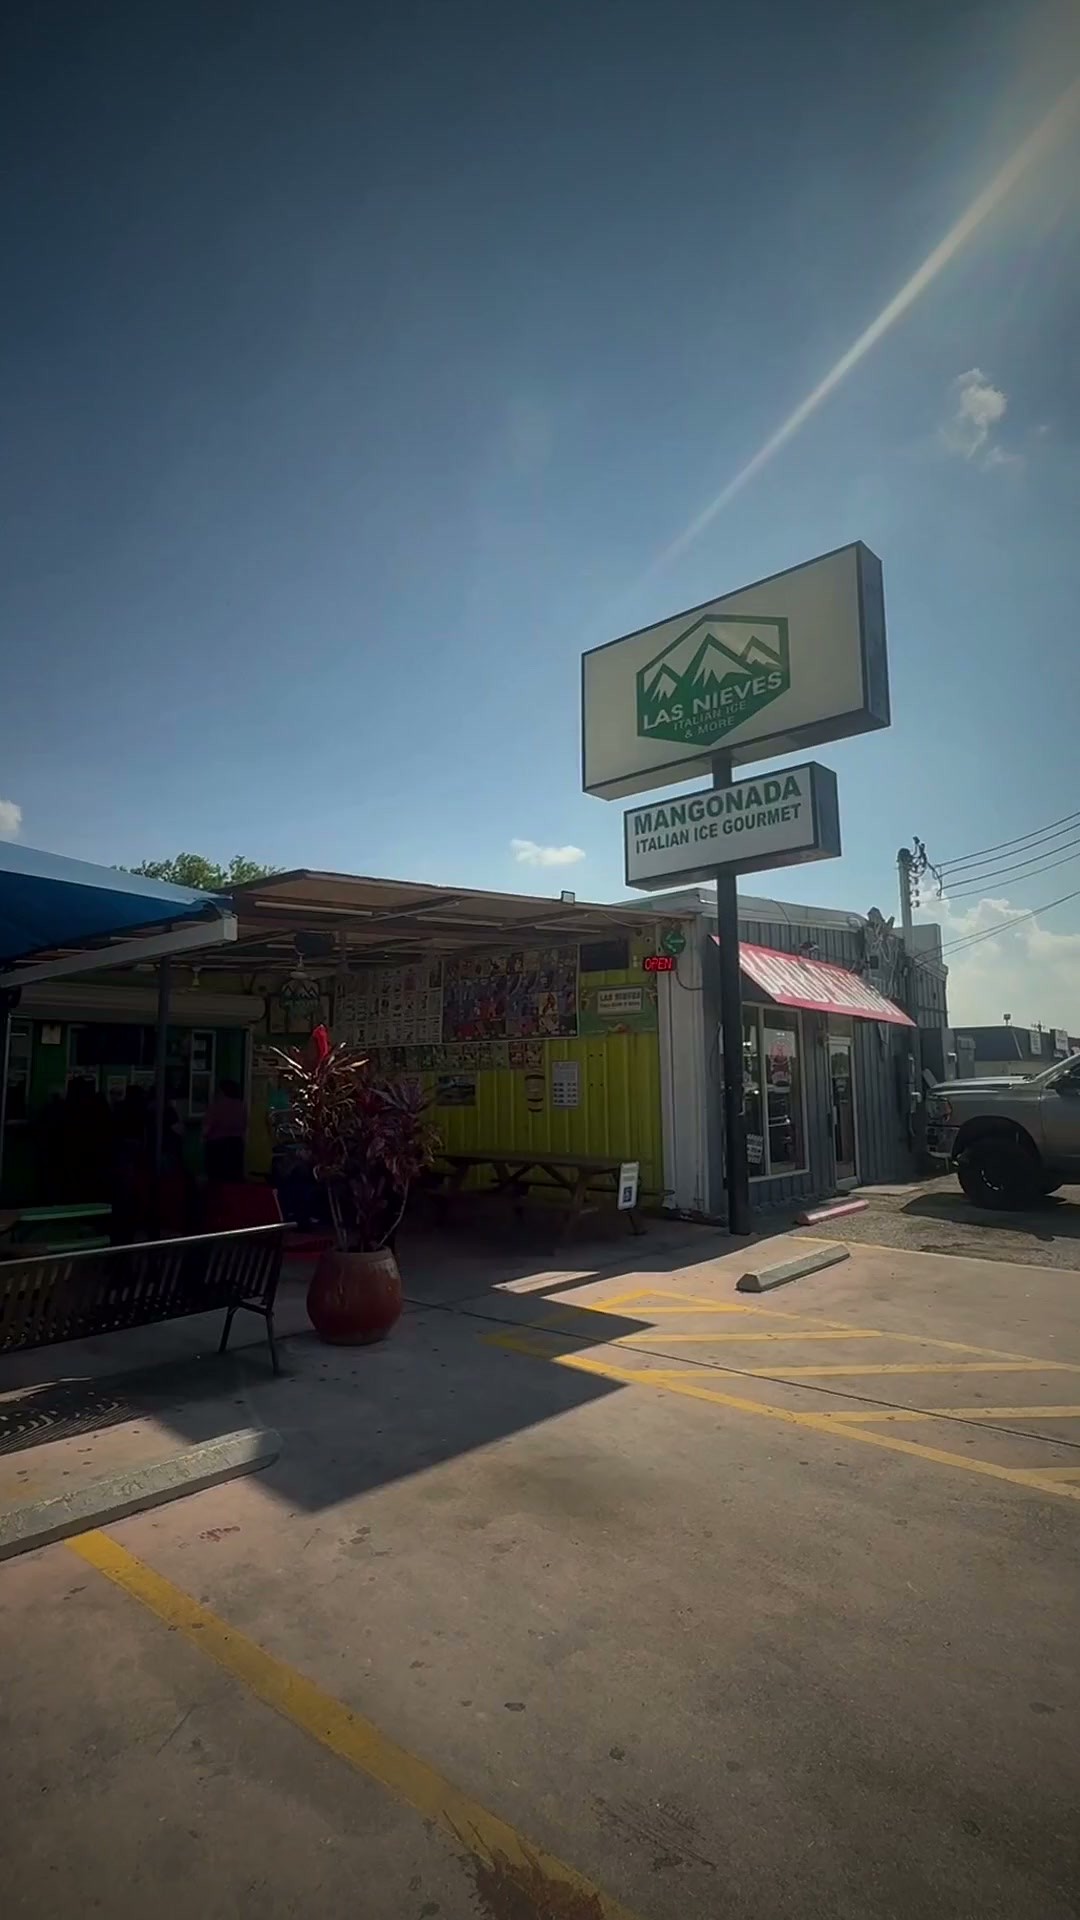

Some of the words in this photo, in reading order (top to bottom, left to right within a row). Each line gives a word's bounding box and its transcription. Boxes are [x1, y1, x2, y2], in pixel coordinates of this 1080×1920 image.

[644, 704, 683, 730] LAS
[693, 672, 782, 714] NIEVES
[673, 708, 721, 731] ITALIAN
[726, 700, 747, 715] ICE
[685, 728, 693, 739] &
[698, 716, 735, 734] MORE
[634, 775, 802, 836] MANGONADA
[636, 828, 690, 854] ITALIAN
[694, 823, 718, 842] ICE
[722, 802, 802, 835] GOURMET
[644, 957, 673, 970] OPEN
